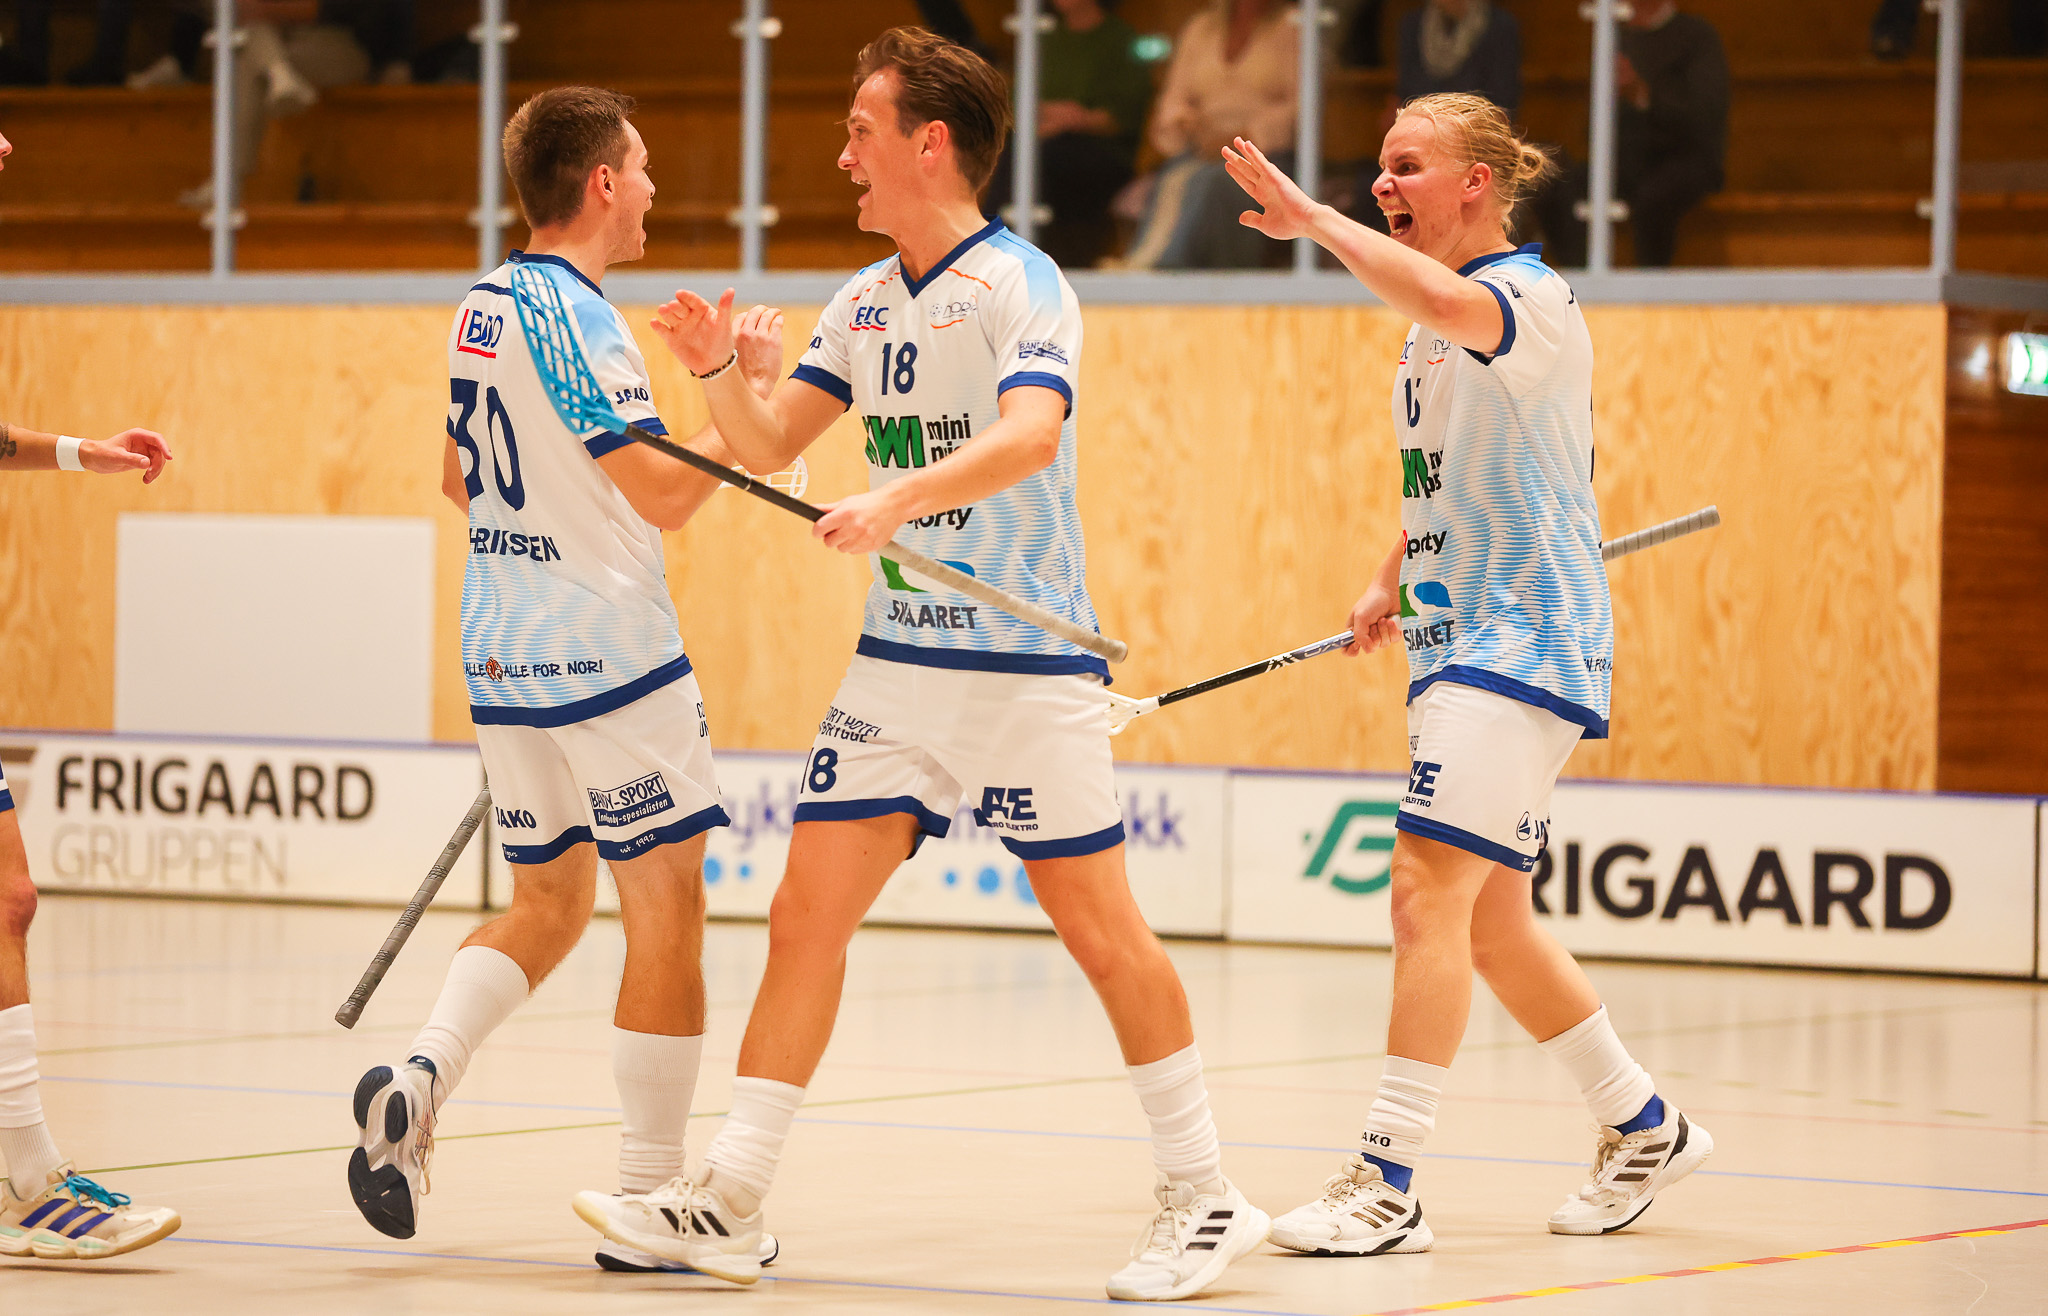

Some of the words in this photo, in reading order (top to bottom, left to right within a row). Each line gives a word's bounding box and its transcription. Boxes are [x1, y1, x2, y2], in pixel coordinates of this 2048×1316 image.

[881, 342, 918, 395] 18
[446, 377, 526, 512] 30
[926, 413, 971, 440] mini
[504, 665, 530, 677] ALLE
[532, 663, 562, 677] FOR
[567, 659, 603, 675] NOR!
[54, 755, 377, 822] FRIGAARD
[50, 824, 290, 888] GRUPPEN
[636, 833, 656, 847] 1992
[1532, 842, 1953, 932] RIGAARD
[1361, 1131, 1391, 1147] AKO
